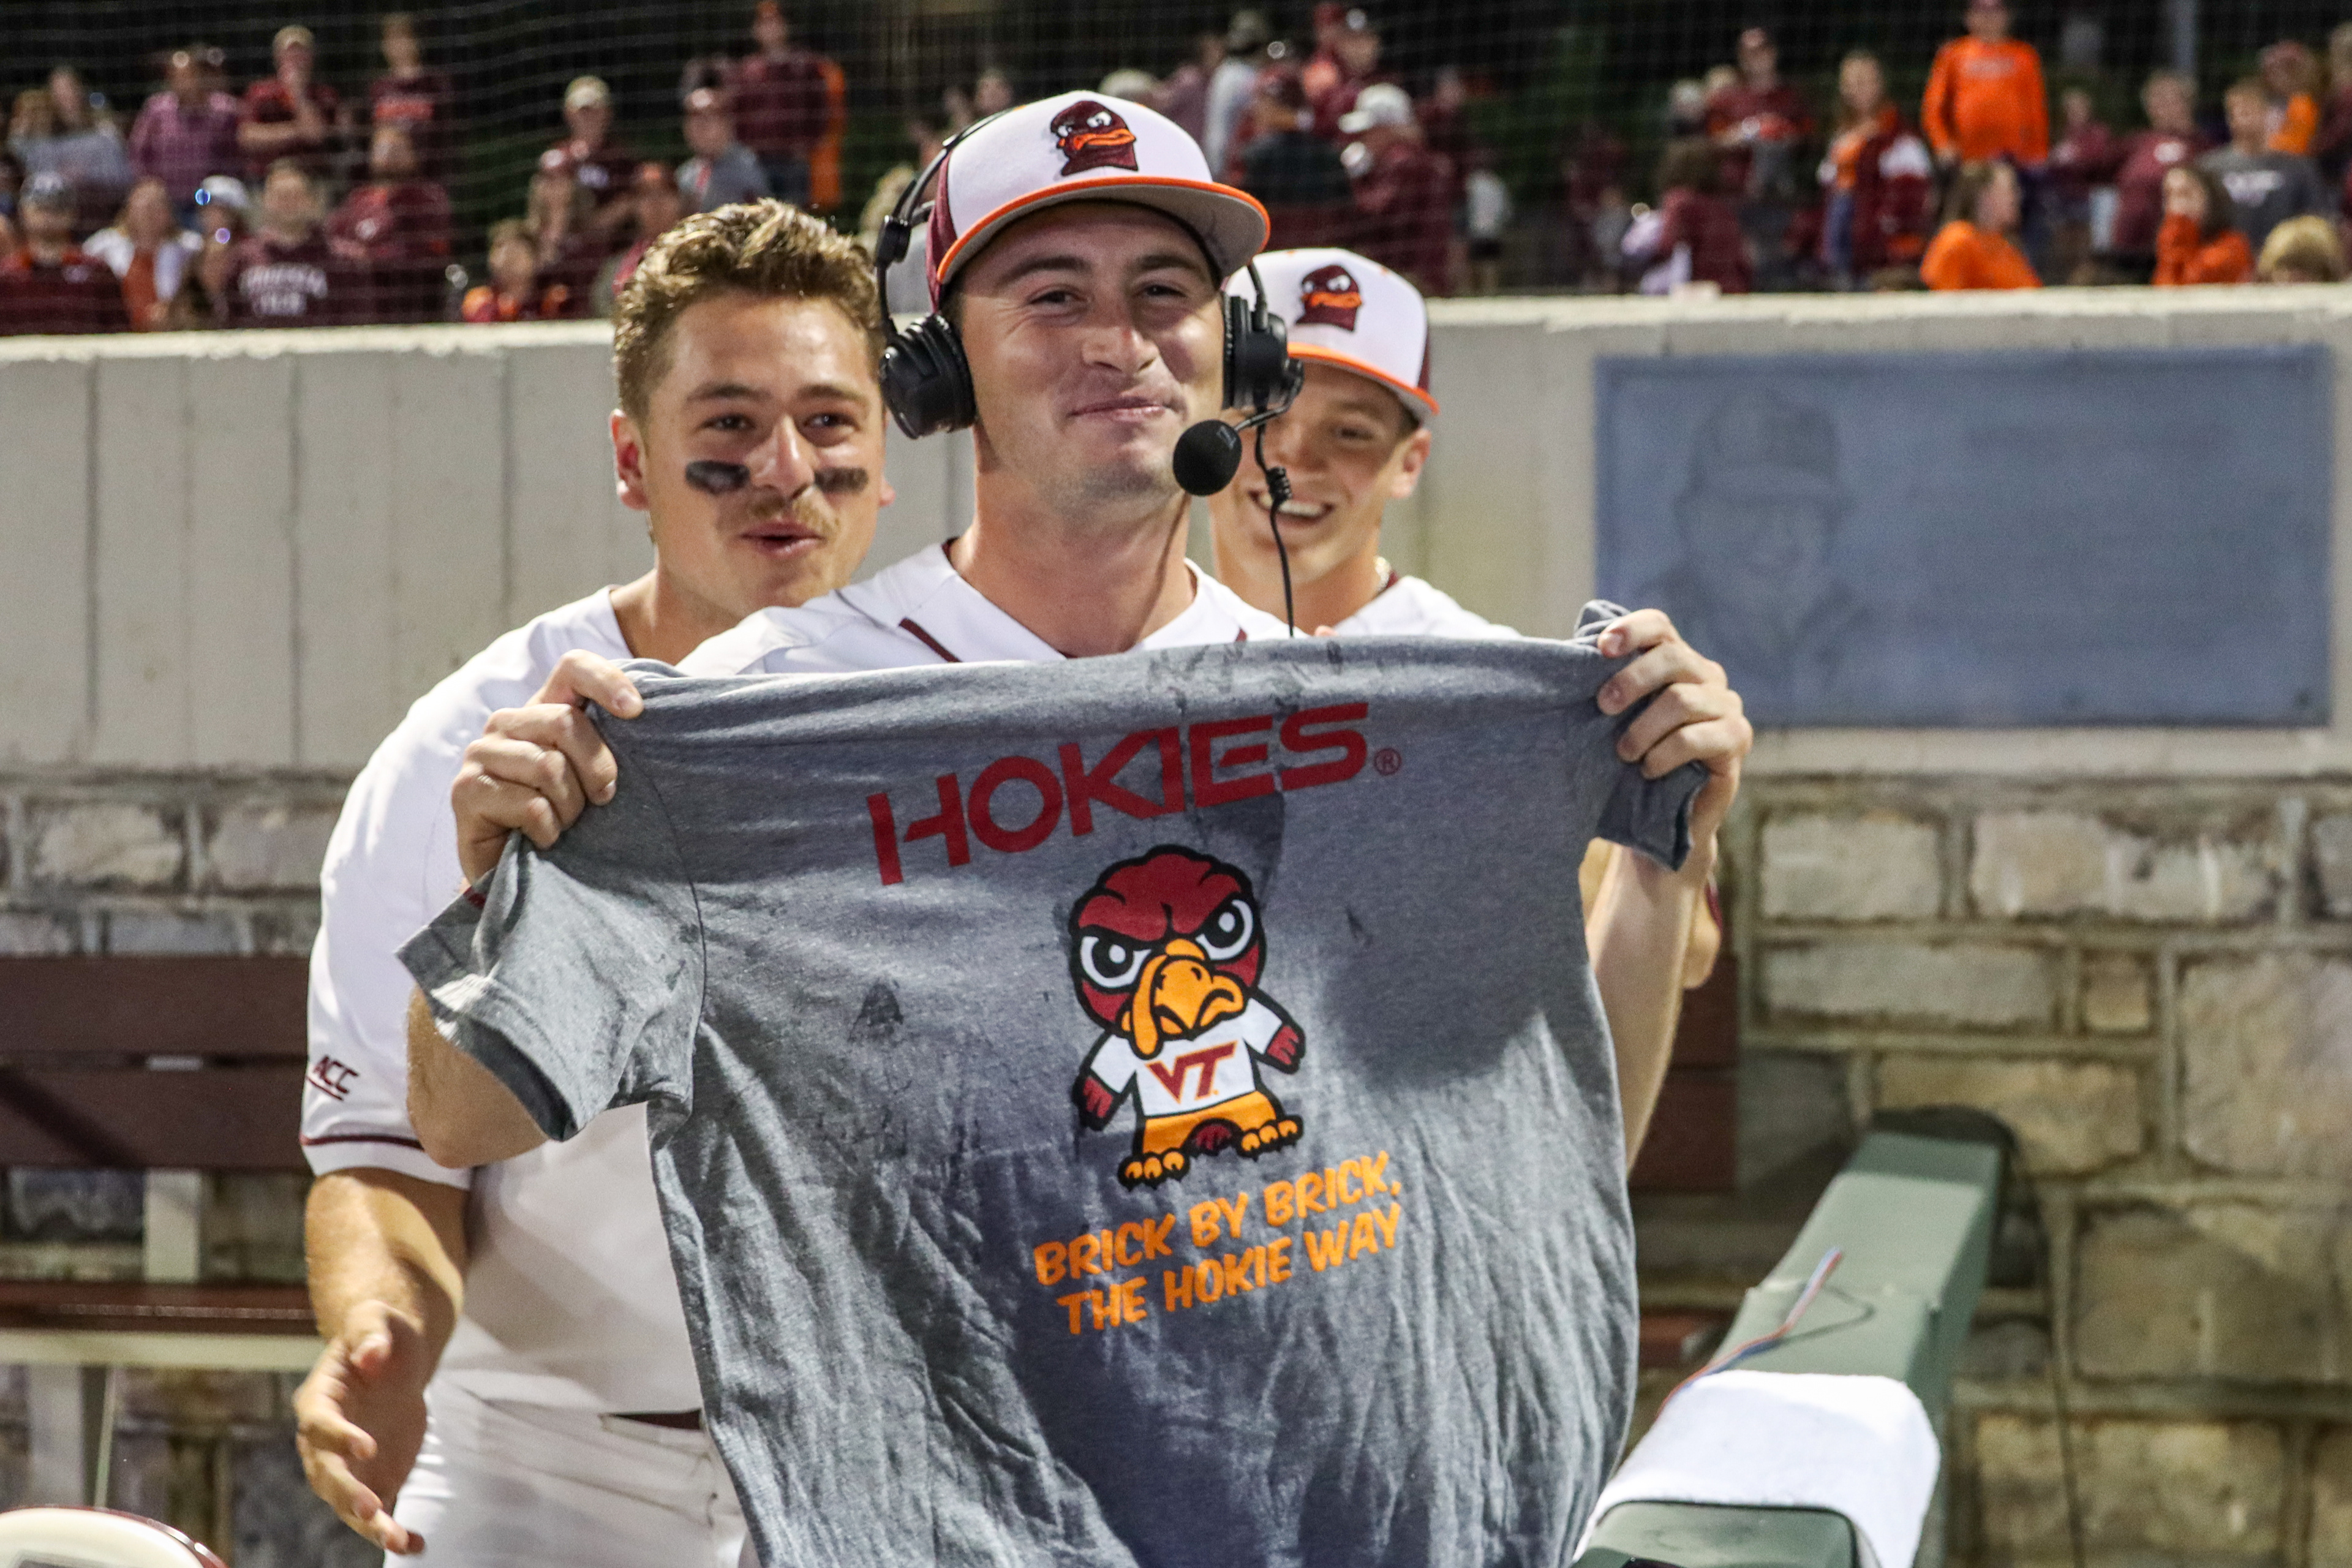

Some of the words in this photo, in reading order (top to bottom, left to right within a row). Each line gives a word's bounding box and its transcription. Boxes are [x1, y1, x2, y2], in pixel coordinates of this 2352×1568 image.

[1146, 1041, 1237, 1103] VT
[1033, 1213, 1177, 1287] BRICK
[1188, 1193, 1249, 1248] BY
[1263, 1151, 1402, 1227] BRICK,
[1057, 1276, 1148, 1335] THE
[1163, 1237, 1292, 1313] HOKIE
[1303, 1202, 1401, 1273] WAY
